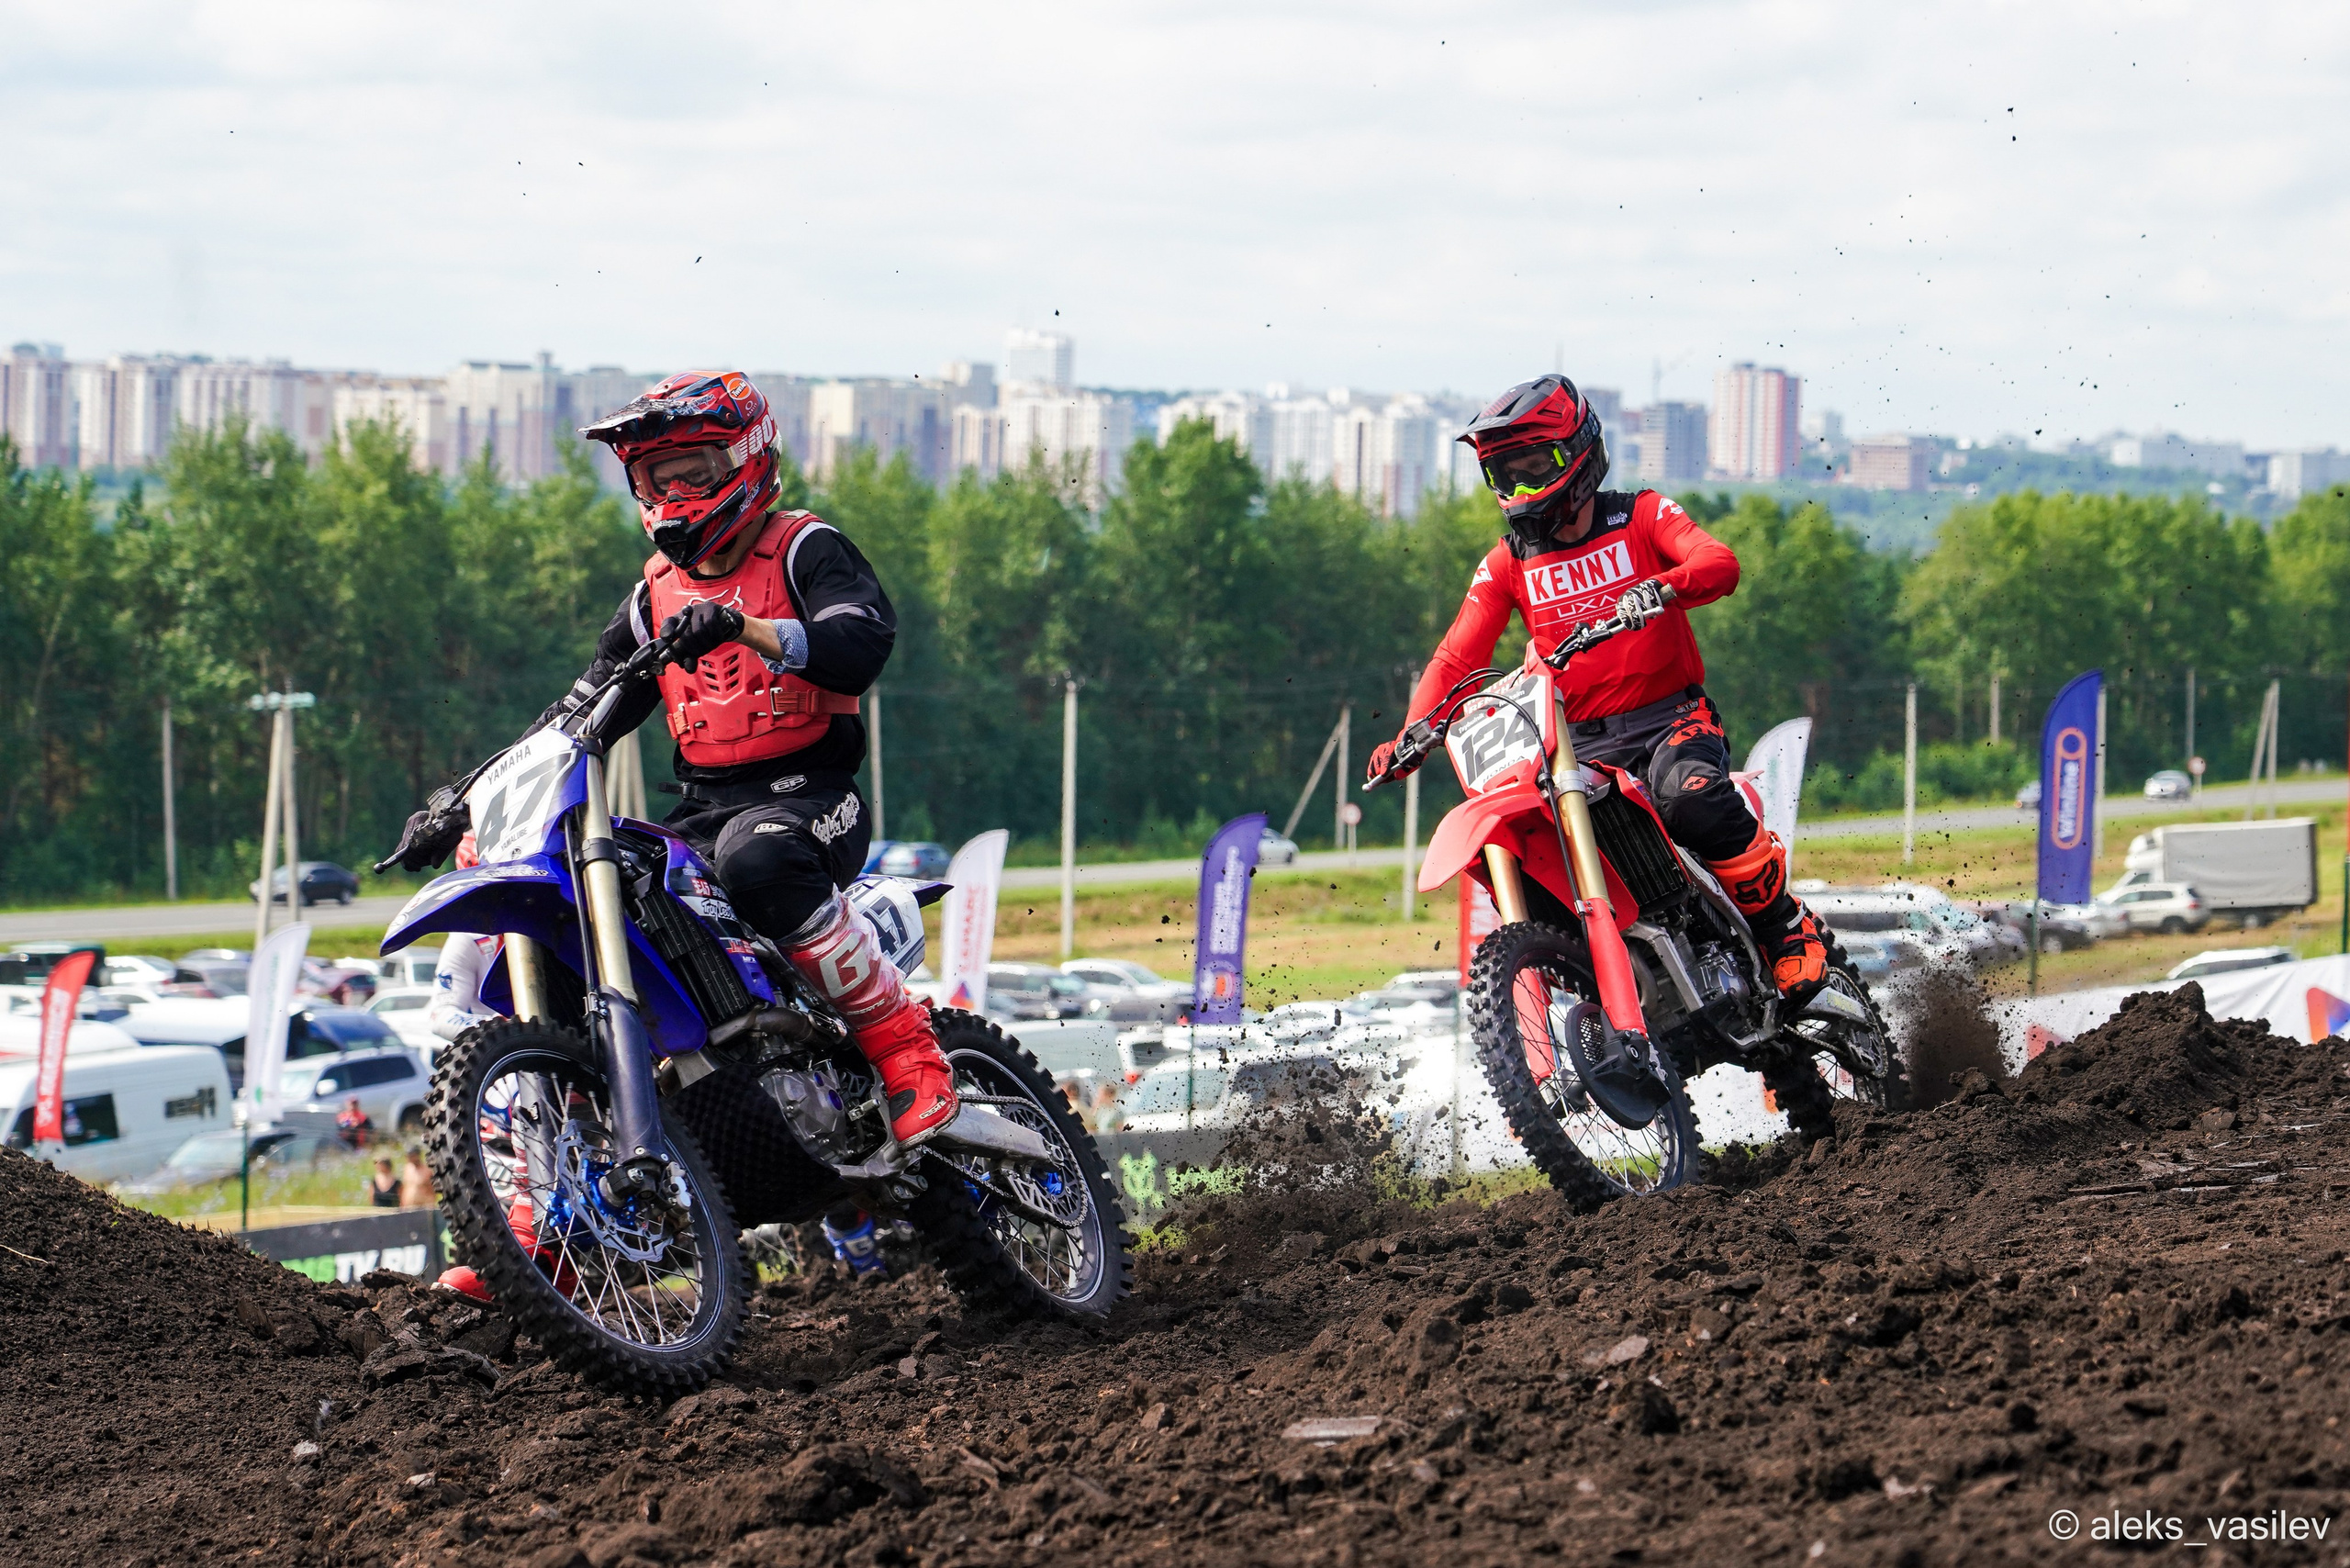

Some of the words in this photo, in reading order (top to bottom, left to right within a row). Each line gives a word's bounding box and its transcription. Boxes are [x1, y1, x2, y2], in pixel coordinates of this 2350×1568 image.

[1531, 545, 1622, 601] KENNY
[487, 745, 532, 786] YAMAHA
[1461, 700, 1540, 787] 124
[773, 777, 806, 791] GP
[1483, 755, 1526, 783] HONDA
[477, 752, 573, 859] 47
[500, 826, 529, 851] YAMALUBE
[861, 896, 911, 957] 47
